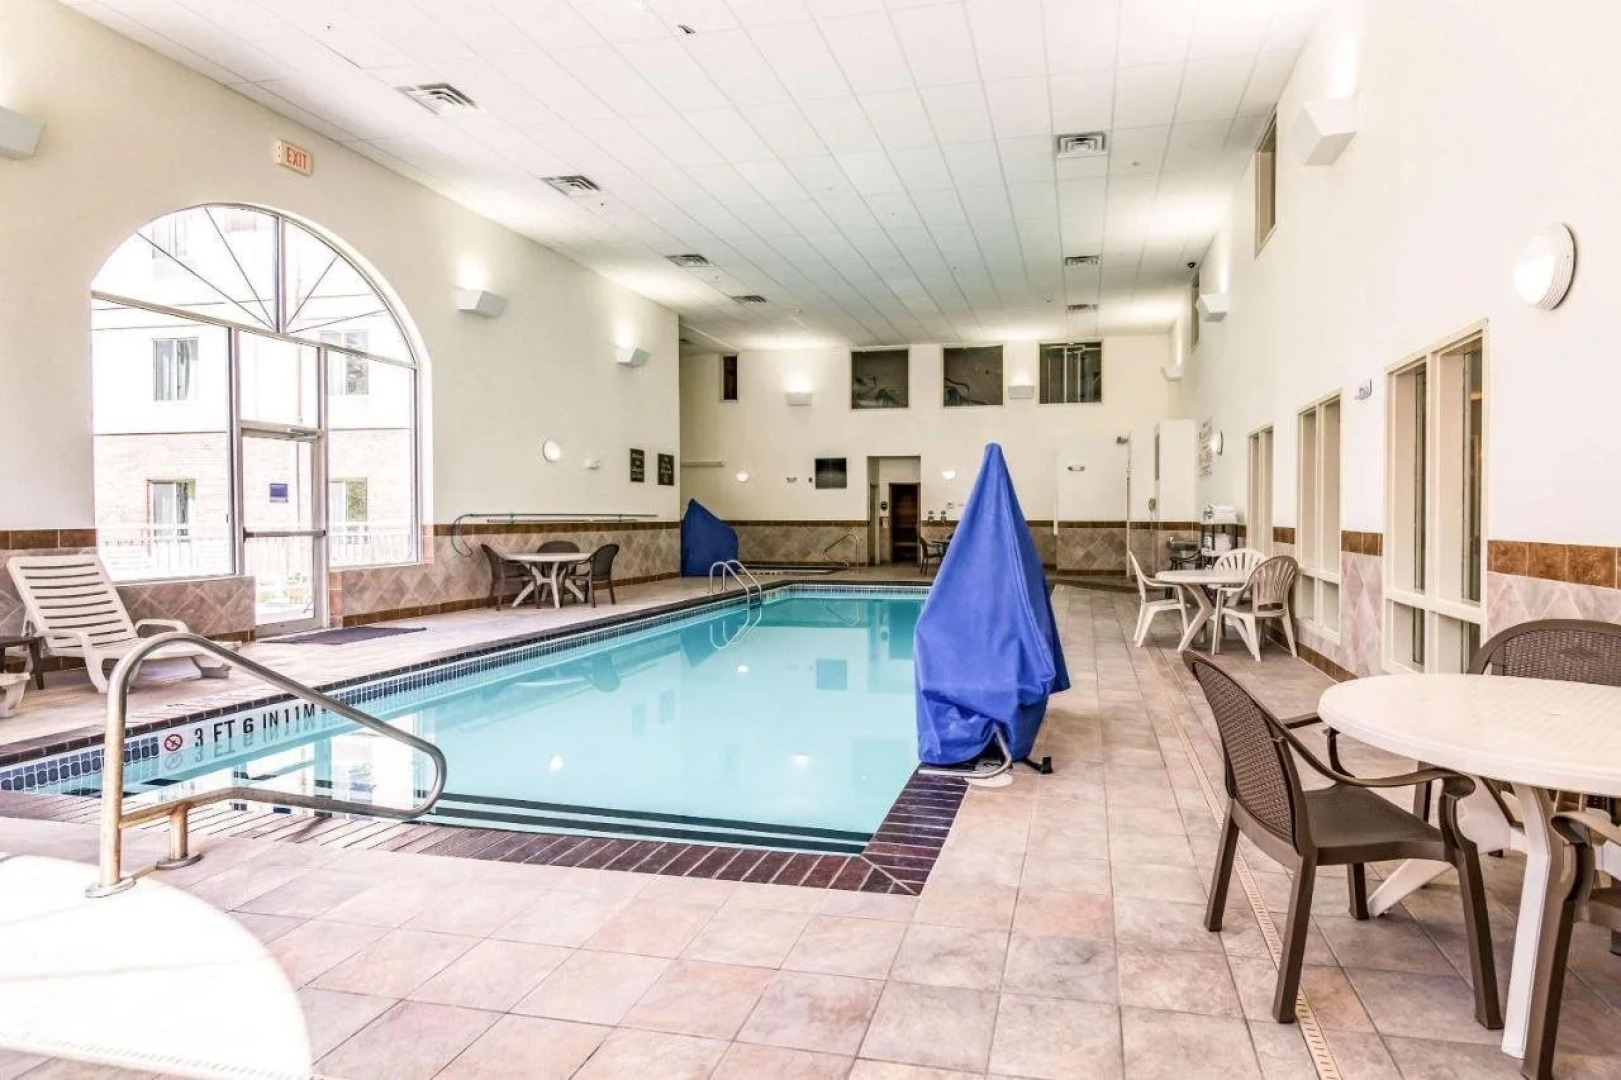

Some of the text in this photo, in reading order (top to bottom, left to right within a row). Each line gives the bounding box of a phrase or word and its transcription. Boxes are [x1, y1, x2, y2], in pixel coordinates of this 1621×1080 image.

[286, 146, 308, 170] EXIT
[194, 727, 204, 747] 3
[213, 719, 236, 742] FT
[242, 717, 254, 734] 6
